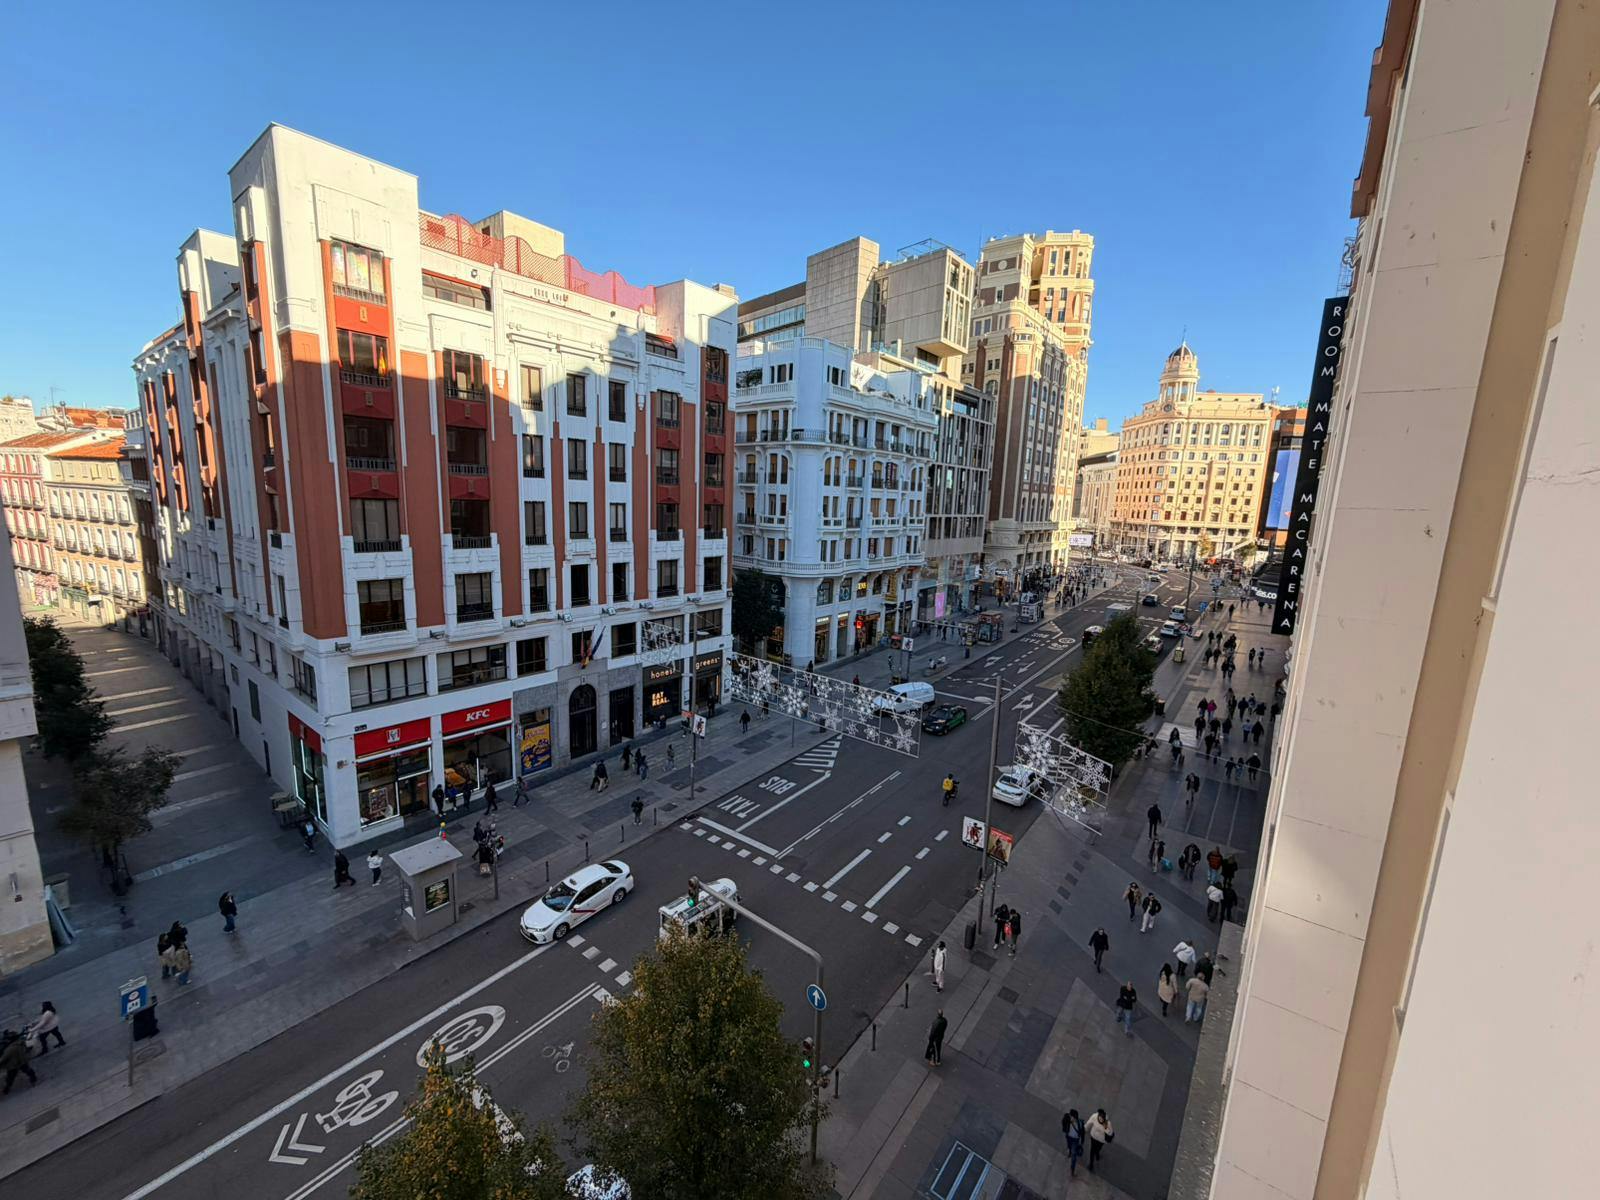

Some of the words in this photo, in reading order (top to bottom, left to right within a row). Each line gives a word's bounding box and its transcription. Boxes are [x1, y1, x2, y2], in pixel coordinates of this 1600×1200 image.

[1320, 305, 1342, 377] ROOM
[1308, 401, 1329, 470] MATE
[1280, 493, 1313, 628] MACARENA
[465, 708, 491, 722] KFC
[716, 794, 761, 819] TAXI
[758, 775, 797, 795] BUS
